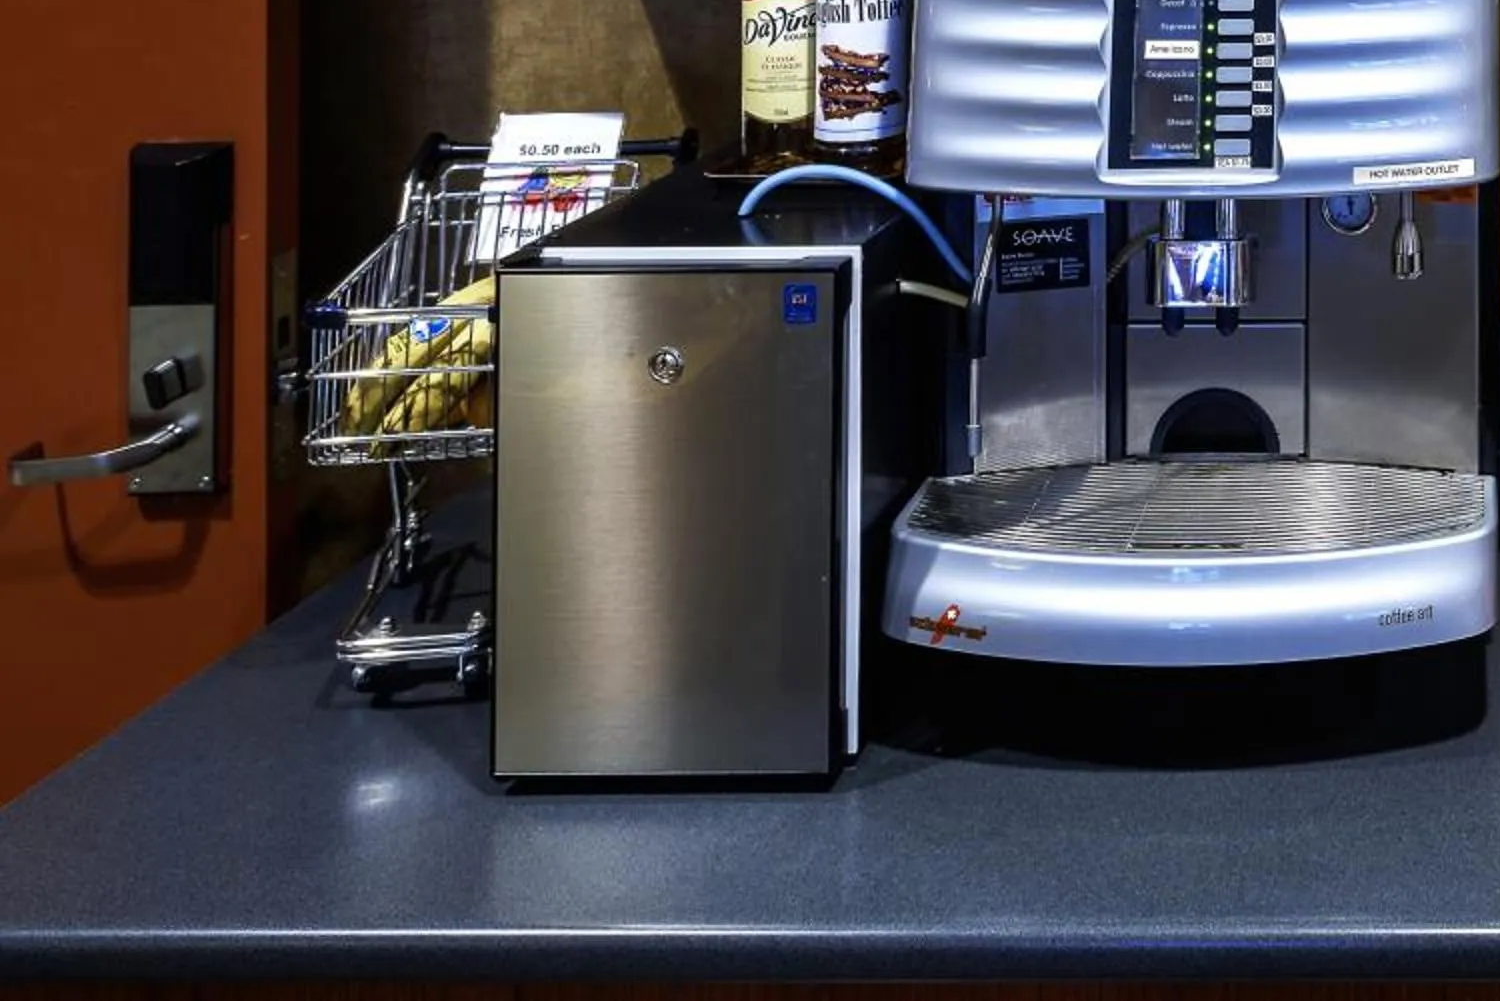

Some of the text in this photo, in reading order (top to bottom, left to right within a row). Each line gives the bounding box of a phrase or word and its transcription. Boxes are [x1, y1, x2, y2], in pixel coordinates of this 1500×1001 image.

[744, 3, 817, 47] DaVinc
[519, 142, 602, 156] $0.50 each
[1369, 164, 1460, 179] HOT WATER OUTLET
[1012, 226, 1073, 246] SOAVE
